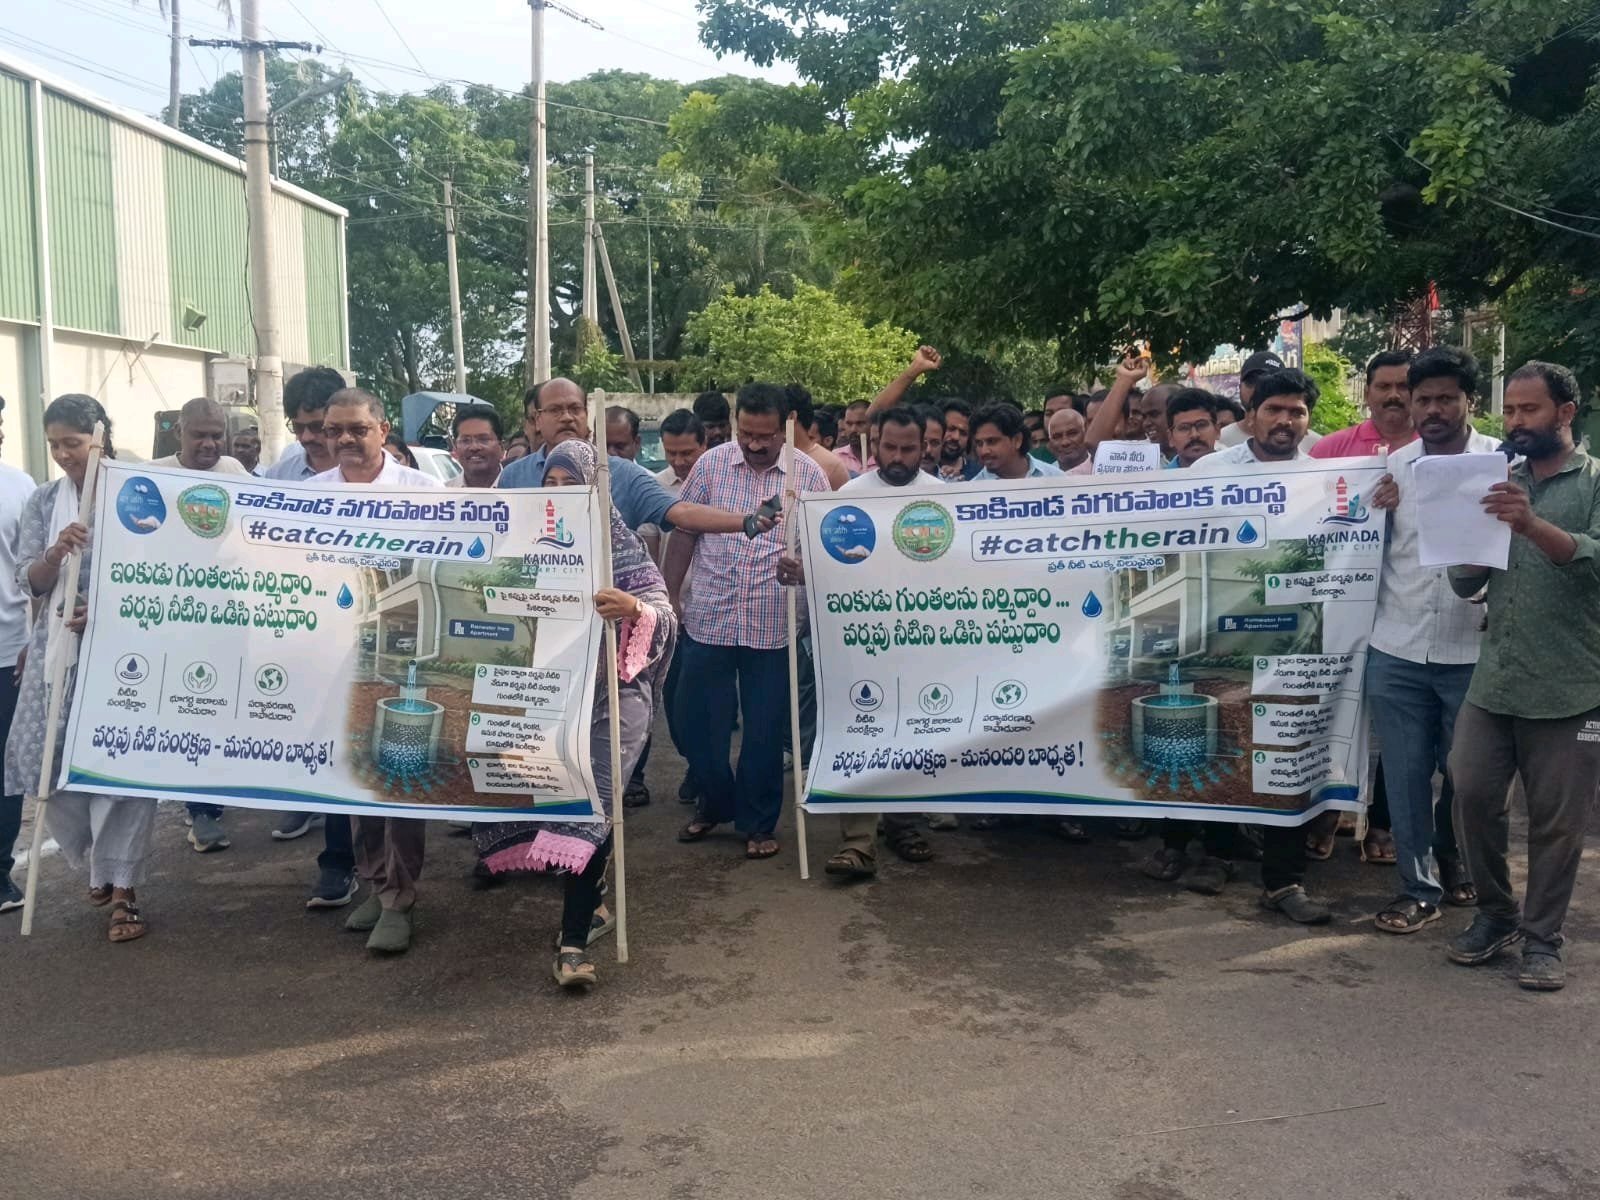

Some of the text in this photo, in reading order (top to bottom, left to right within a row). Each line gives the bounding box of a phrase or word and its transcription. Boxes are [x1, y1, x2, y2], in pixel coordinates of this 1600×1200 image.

[235, 491, 510, 533] కాకినాడ నగరపాలక సంస్థ
[955, 480, 1287, 521] కాకినాడ నగరపాలక సంస్థ
[248, 520, 464, 557] #catchtherain
[979, 521, 1230, 556] #catchtherain
[1307, 530, 1380, 546] KAKINADA
[524, 553, 584, 566] KAKINADA
[111, 561, 173, 585] ఇంకుడు
[176, 562, 250, 591] గుంతలను
[253, 570, 312, 606] నిర్మిద్దాం
[120, 594, 318, 638] వర్షపు నీటిని ఒడిసి పట్టుదాం
[827, 588, 892, 614] ఇంకుడు
[896, 586, 978, 612] గుంతలను
[982, 587, 1051, 620] నిర్మిద్దాం
[844, 619, 1061, 656] వర్షపు నీటిని ఒడిసి పట్టుదాం
[117, 686, 138, 698] నీటిని
[855, 714, 876, 724] నీటిని
[92, 725, 130, 760] వర్షపు
[132, 726, 157, 751] నీటి
[158, 729, 211, 766] సంరక్షణ
[224, 735, 284, 762] మనందరి
[832, 750, 867, 778] వర్షపు
[867, 748, 892, 770] నీటి
[892, 749, 947, 778] సంరక్షణ
[960, 746, 1025, 768] మనందరి
